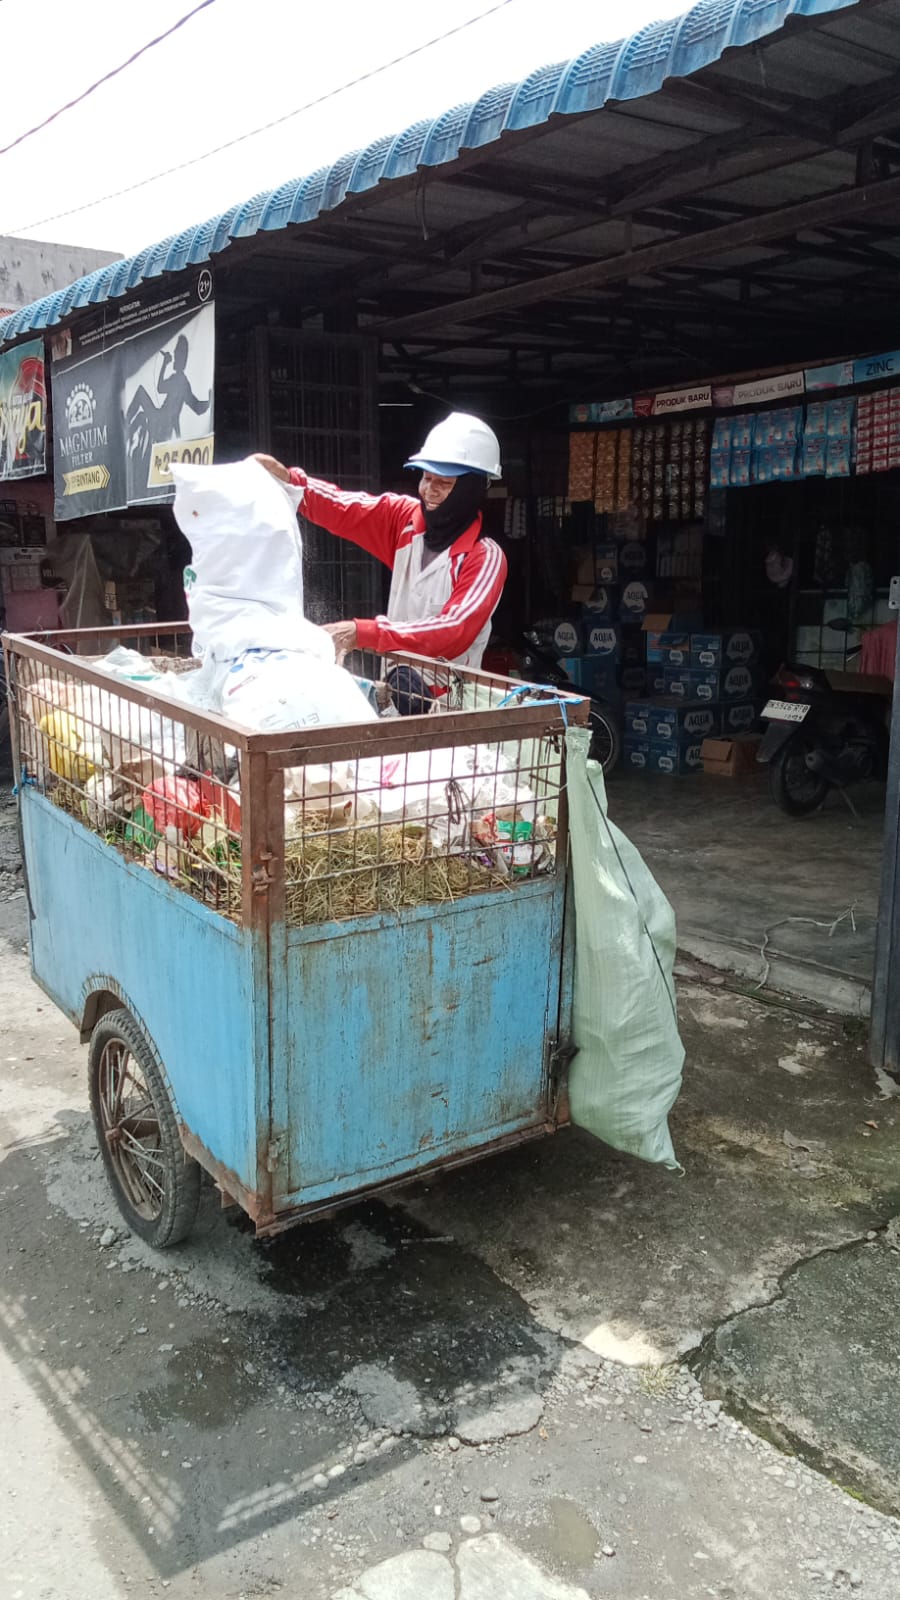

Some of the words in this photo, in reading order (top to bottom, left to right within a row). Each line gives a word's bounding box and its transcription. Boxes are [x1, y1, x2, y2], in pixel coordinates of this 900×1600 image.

[866, 358, 895, 376] ZINC
[738, 387, 775, 399] PRODUK
[777, 379, 802, 392] BARU
[656, 398, 686, 408] PRODUK
[688, 392, 710, 403] BARU
[59, 425, 108, 457] MAGNUM
[71, 451, 93, 468] FILTER
[558, 631, 575, 641] AQUA
[593, 632, 614, 643] AQUA
[688, 713, 709, 727] AQUA
[688, 748, 702, 761] AQ
